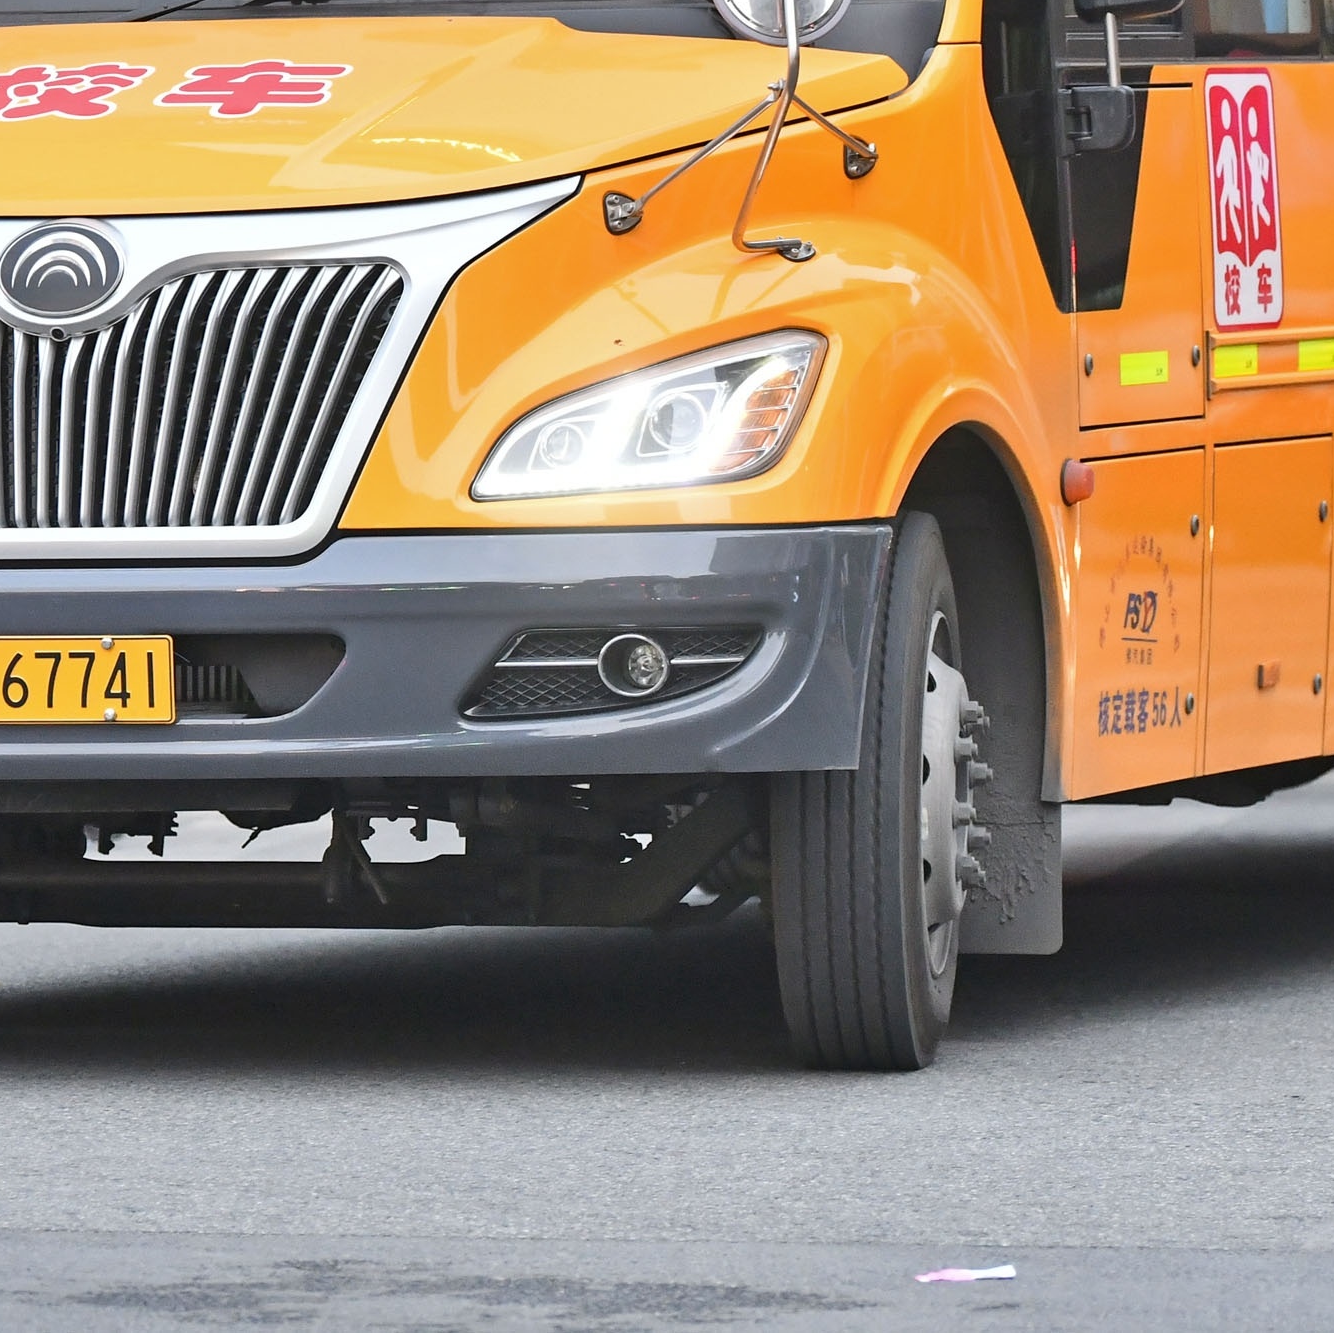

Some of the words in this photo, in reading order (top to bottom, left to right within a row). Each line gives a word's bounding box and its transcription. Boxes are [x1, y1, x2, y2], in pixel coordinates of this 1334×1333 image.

[1224, 262, 1274, 316] 校车
[1097, 686, 1183, 737] 核定载客56人
